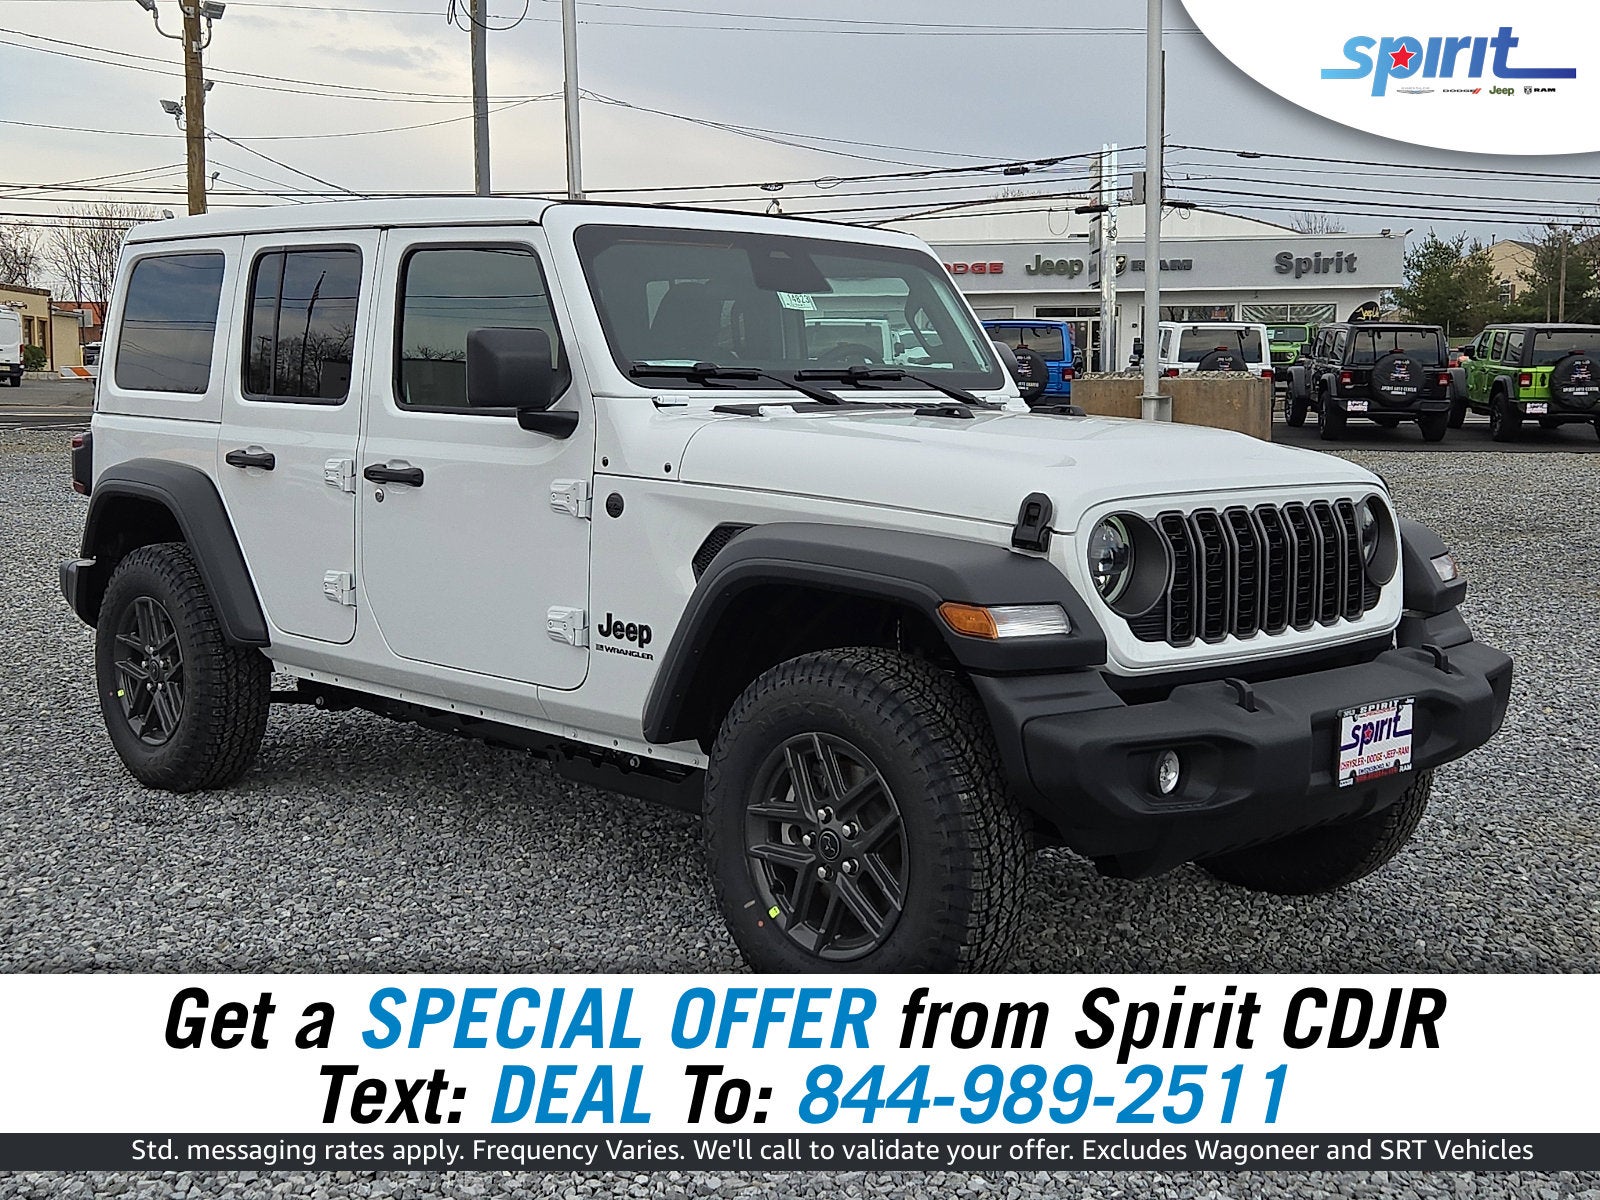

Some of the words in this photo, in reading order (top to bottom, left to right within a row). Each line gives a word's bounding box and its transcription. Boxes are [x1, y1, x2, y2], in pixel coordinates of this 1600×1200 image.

[943, 262, 1004, 275] DGE
[1026, 254, 1083, 279] Jeep
[1275, 251, 1357, 278] Spirit
[598, 612, 653, 649] Jeep
[604, 645, 654, 661] WRANGLER
[1360, 700, 1399, 714] SPIRIT
